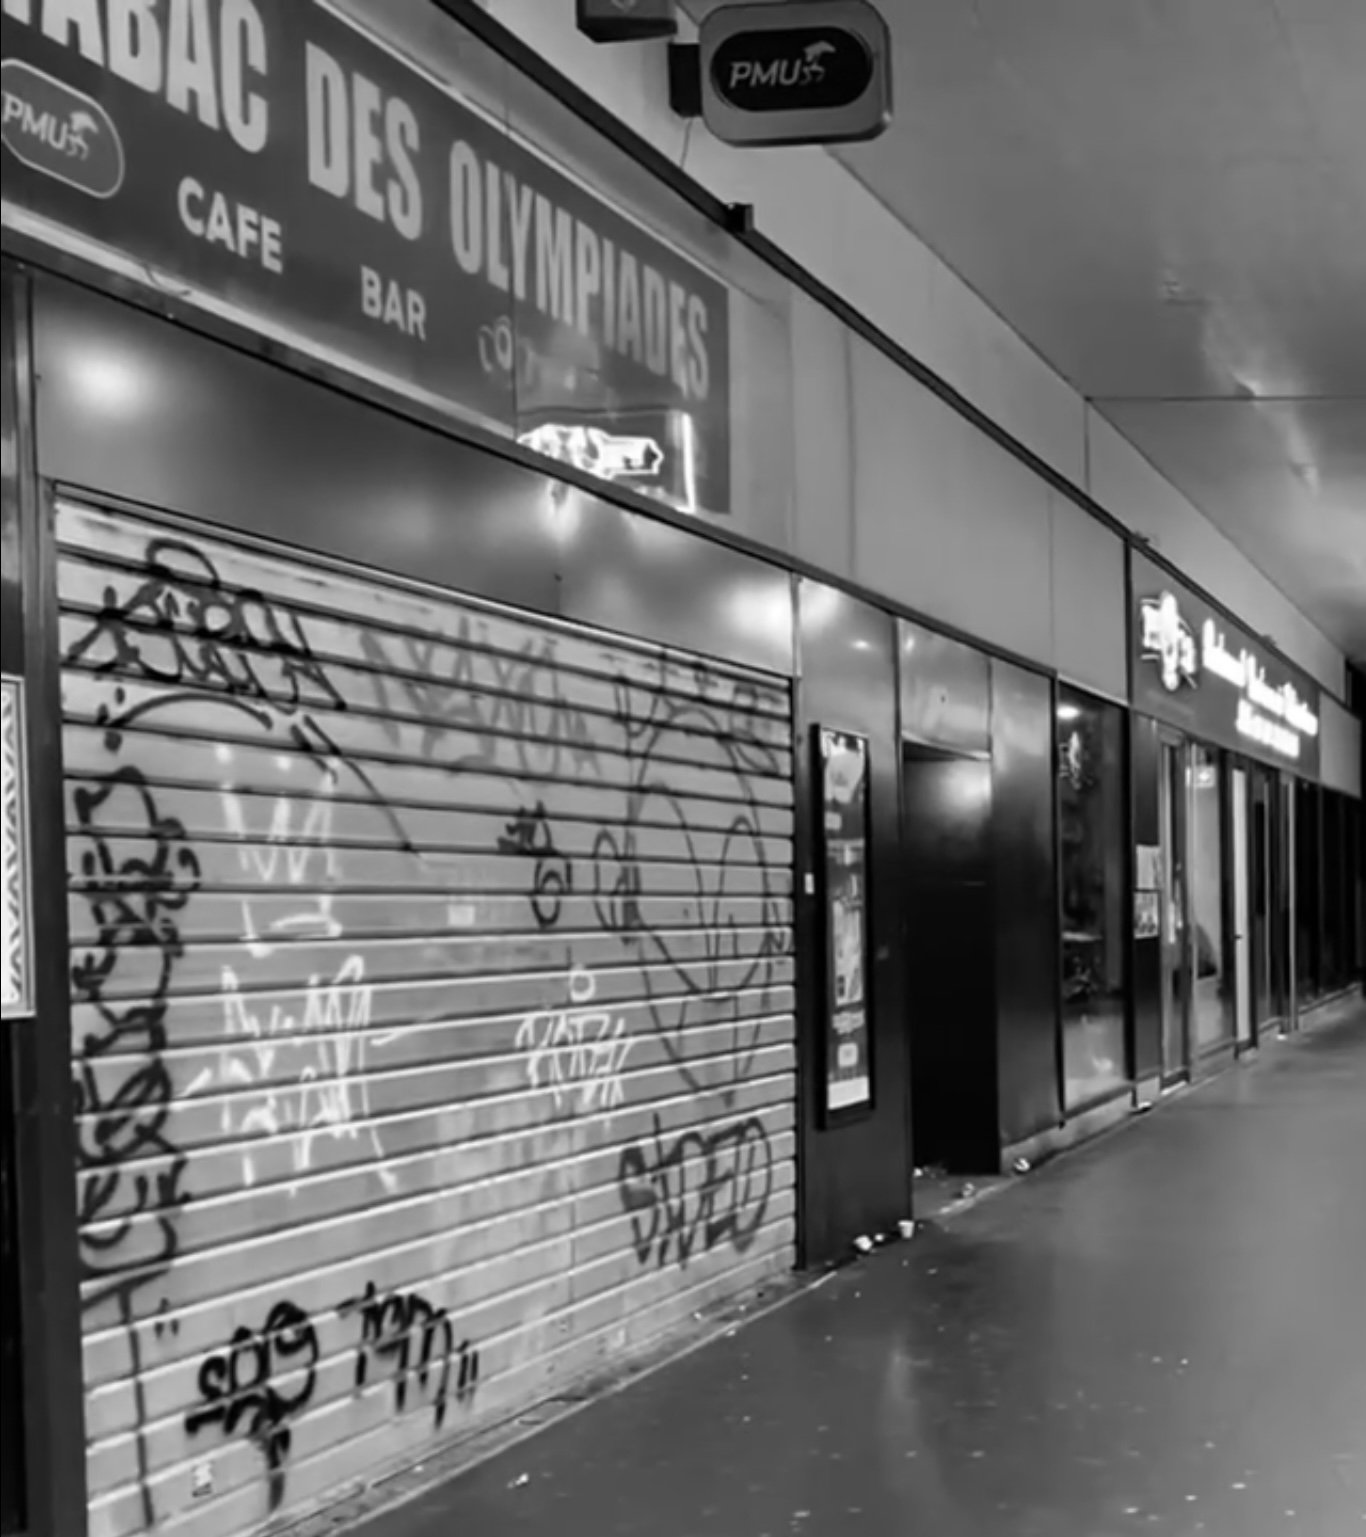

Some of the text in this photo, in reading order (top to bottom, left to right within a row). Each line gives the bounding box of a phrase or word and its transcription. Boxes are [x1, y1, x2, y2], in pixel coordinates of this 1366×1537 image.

[730, 59, 801, 89] PMU
[3, 91, 68, 150] PMU
[178, 177, 282, 274] CAFE
[306, 42, 424, 240] DES
[450, 140, 709, 399] OLYMPIADES
[361, 265, 427, 341] BAR
